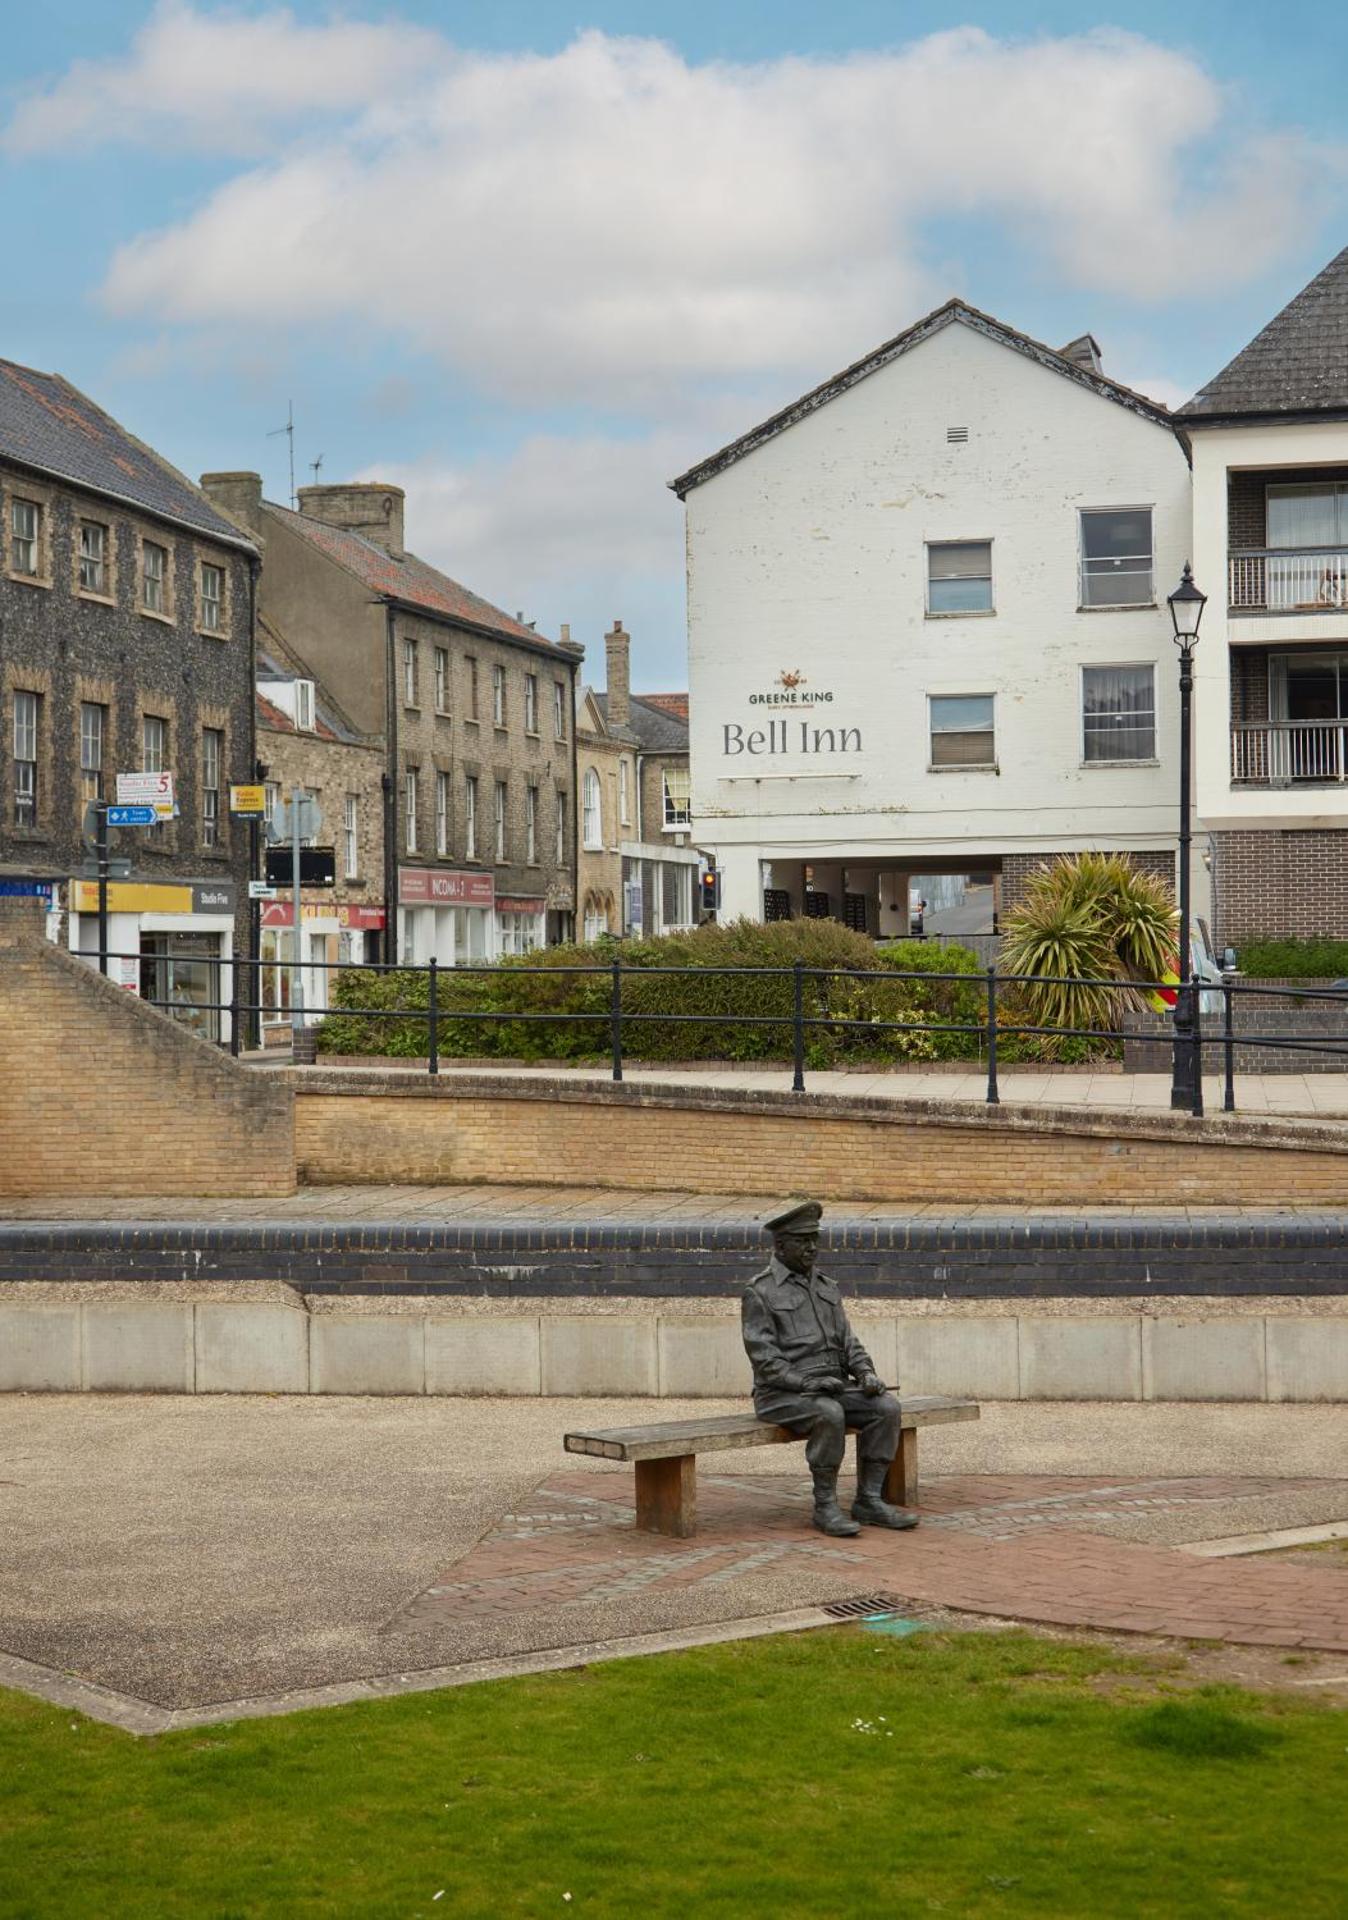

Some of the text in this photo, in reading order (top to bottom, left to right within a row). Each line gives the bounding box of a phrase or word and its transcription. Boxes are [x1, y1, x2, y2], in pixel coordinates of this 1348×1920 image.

[749, 691, 833, 705] GREENE KING
[722, 720, 863, 755] Bell Inn
[158, 776, 169, 793] 5
